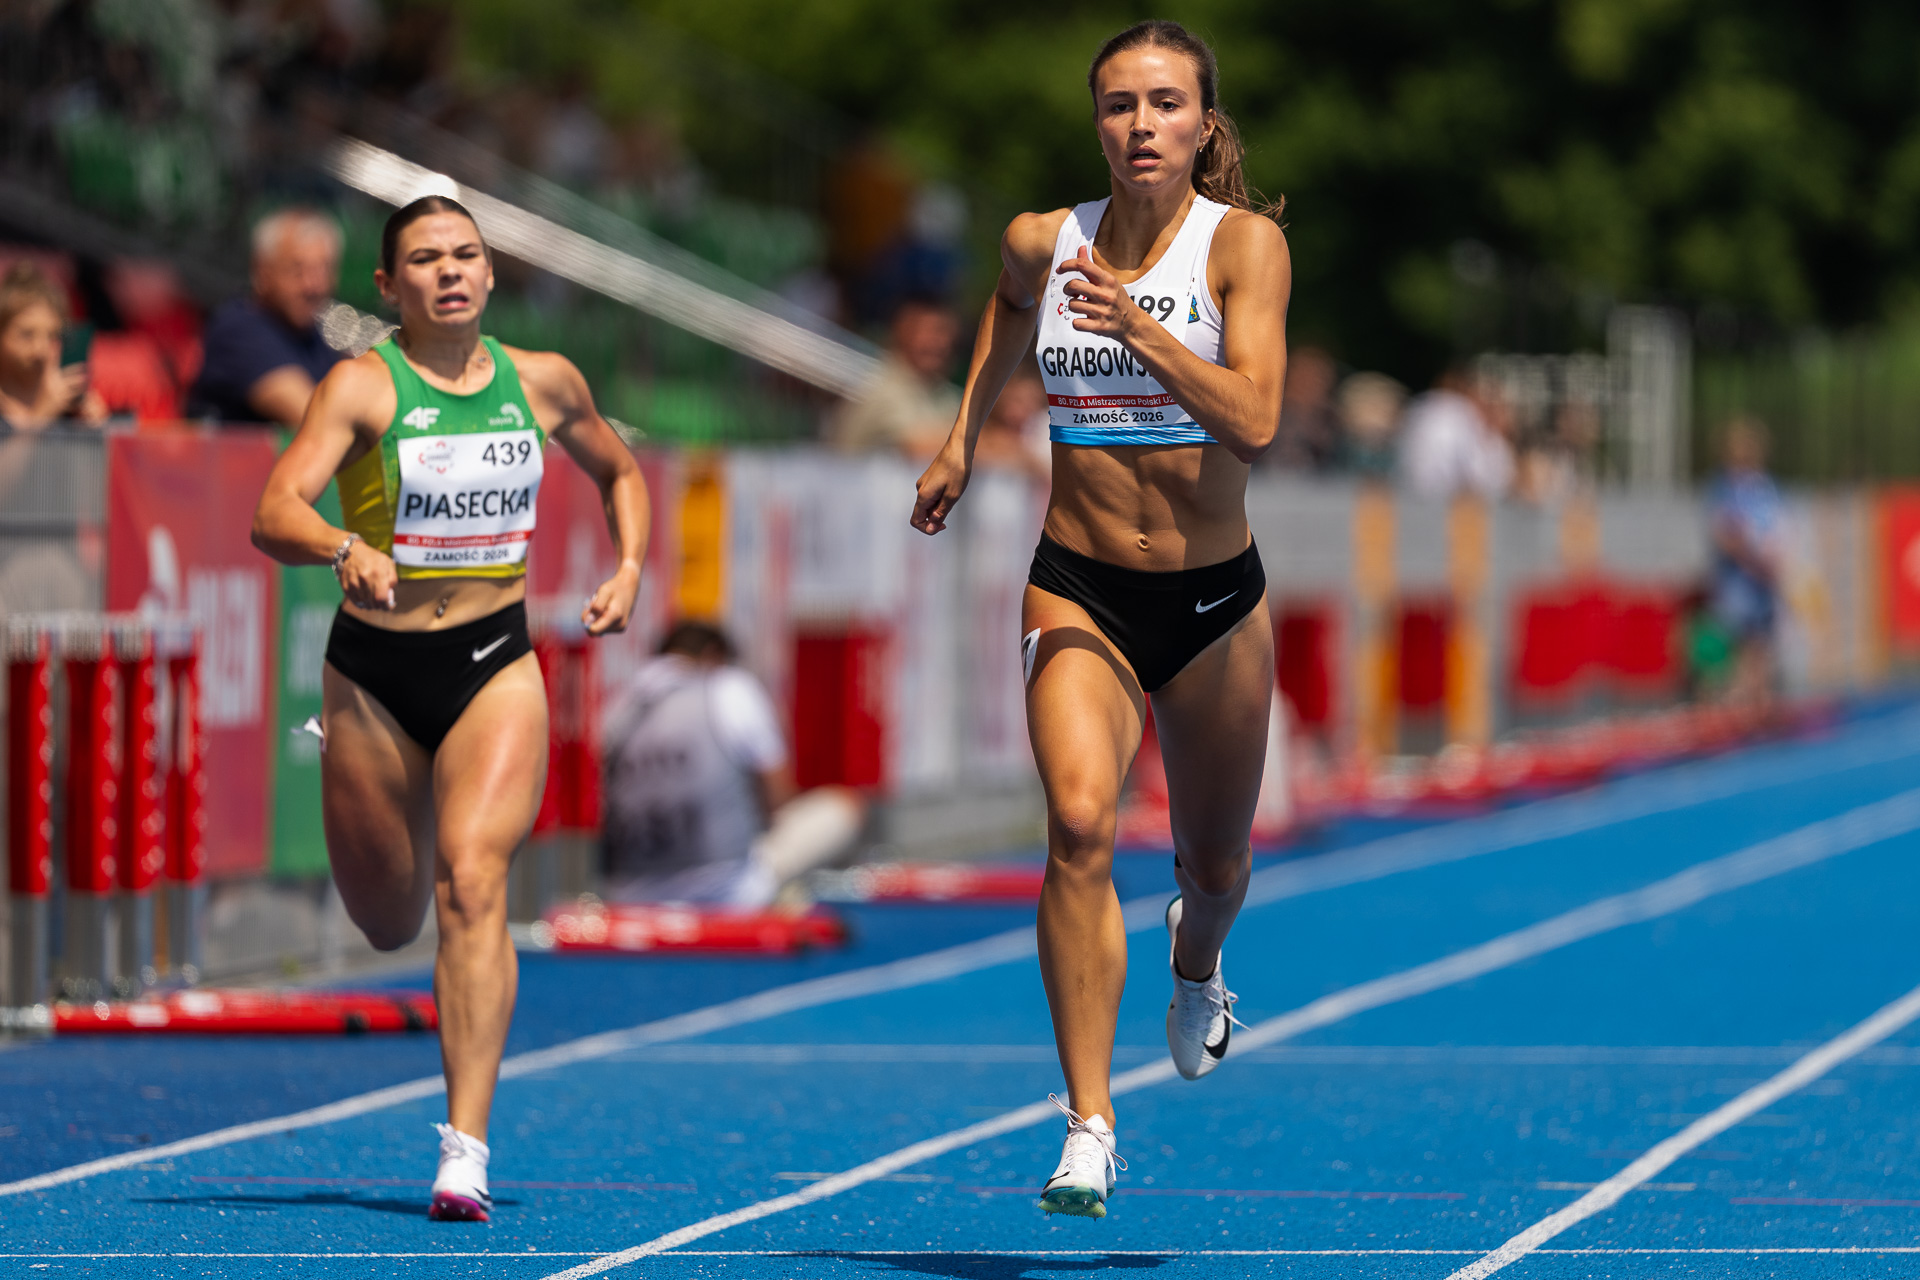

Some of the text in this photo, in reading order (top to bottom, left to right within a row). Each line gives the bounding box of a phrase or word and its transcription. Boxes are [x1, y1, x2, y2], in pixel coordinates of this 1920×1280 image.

[1130, 295, 1176, 322] 99
[1042, 346, 1152, 378] GRABOW
[1069, 398, 1086, 407] PZLA
[1087, 397, 1137, 407] Mistrzostwa
[1137, 396, 1162, 406] Polski
[1162, 395, 1175, 404] U2
[402, 405, 441, 430] 4F
[1072, 409, 1164, 424] ZAMOŚĆ 2026
[482, 440, 532, 467] 439
[404, 486, 530, 519] PIASECKA
[424, 548, 479, 562] ZAMOŚĆ
